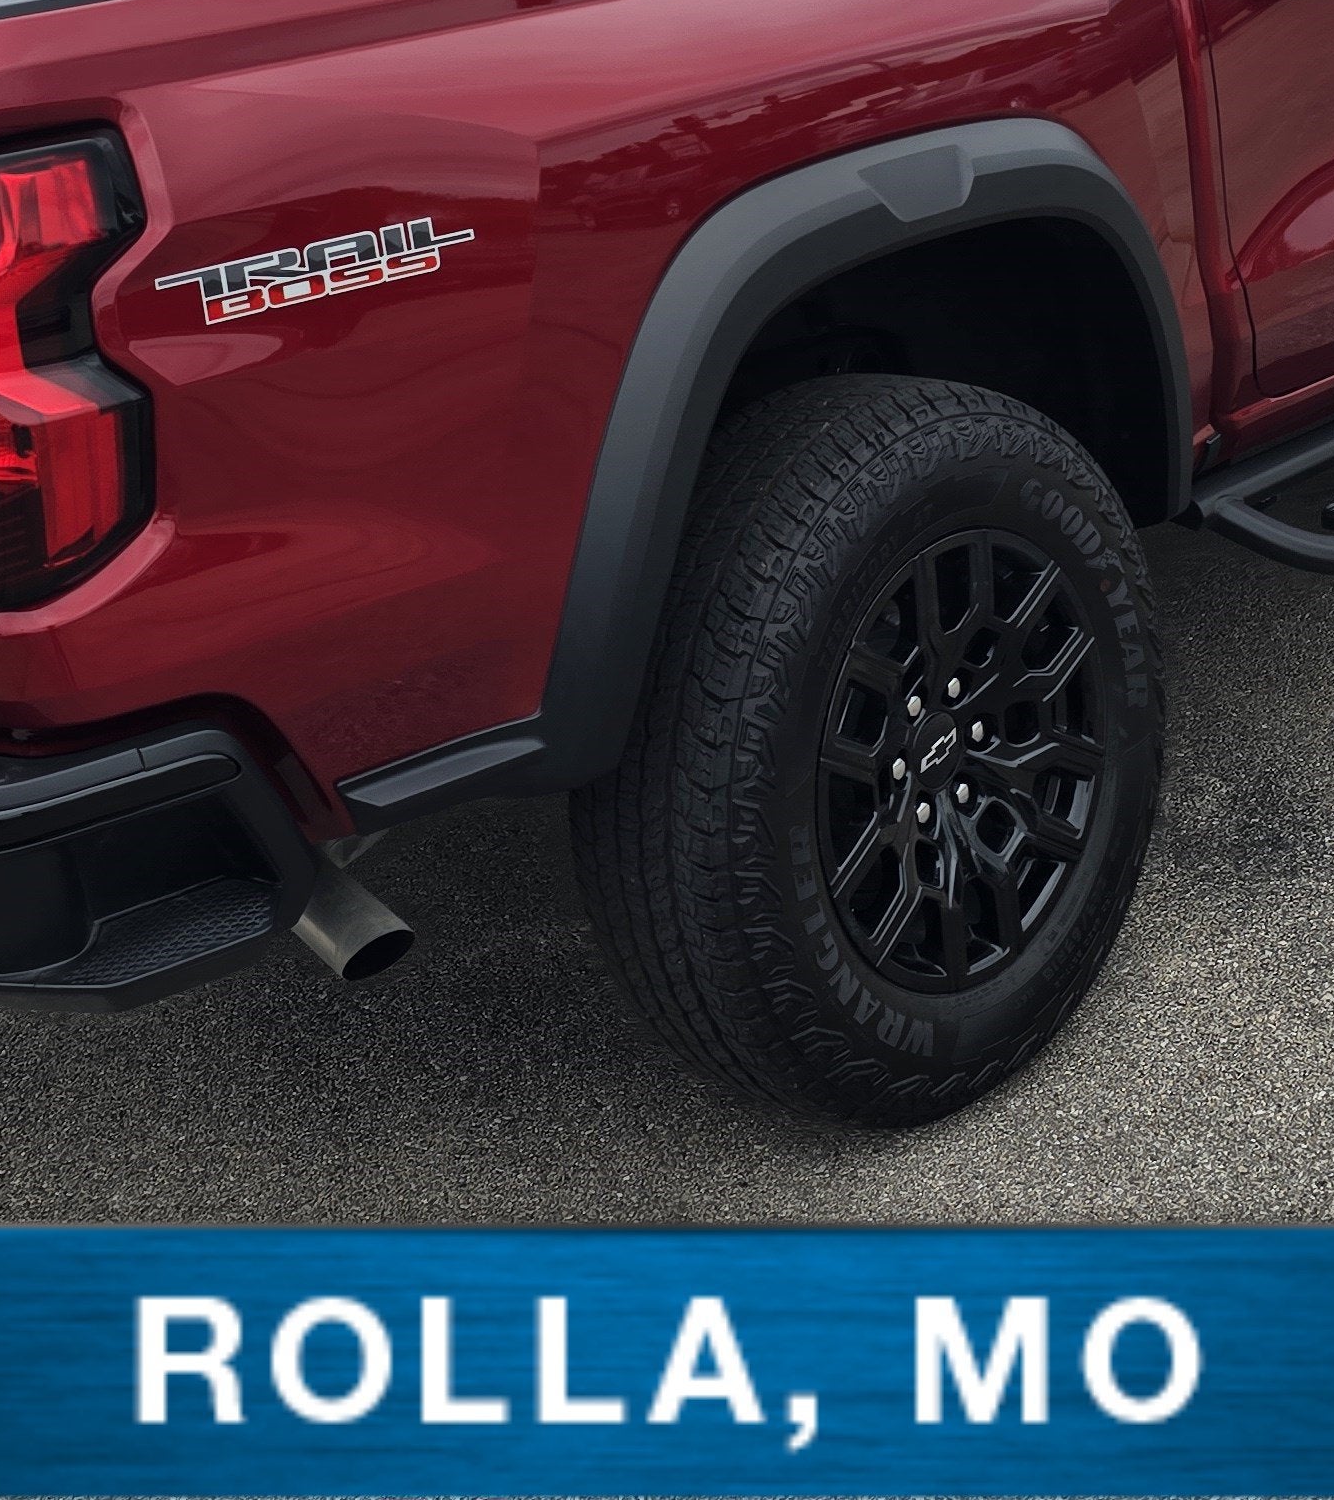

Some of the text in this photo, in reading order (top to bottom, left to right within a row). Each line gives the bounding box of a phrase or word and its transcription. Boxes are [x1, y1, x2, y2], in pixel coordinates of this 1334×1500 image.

[155, 217, 475, 299] TRAIL
[202, 246, 441, 316] BOSS
[1019, 477, 1148, 708] GOODYEAR
[789, 825, 935, 1057] WRANGLER
